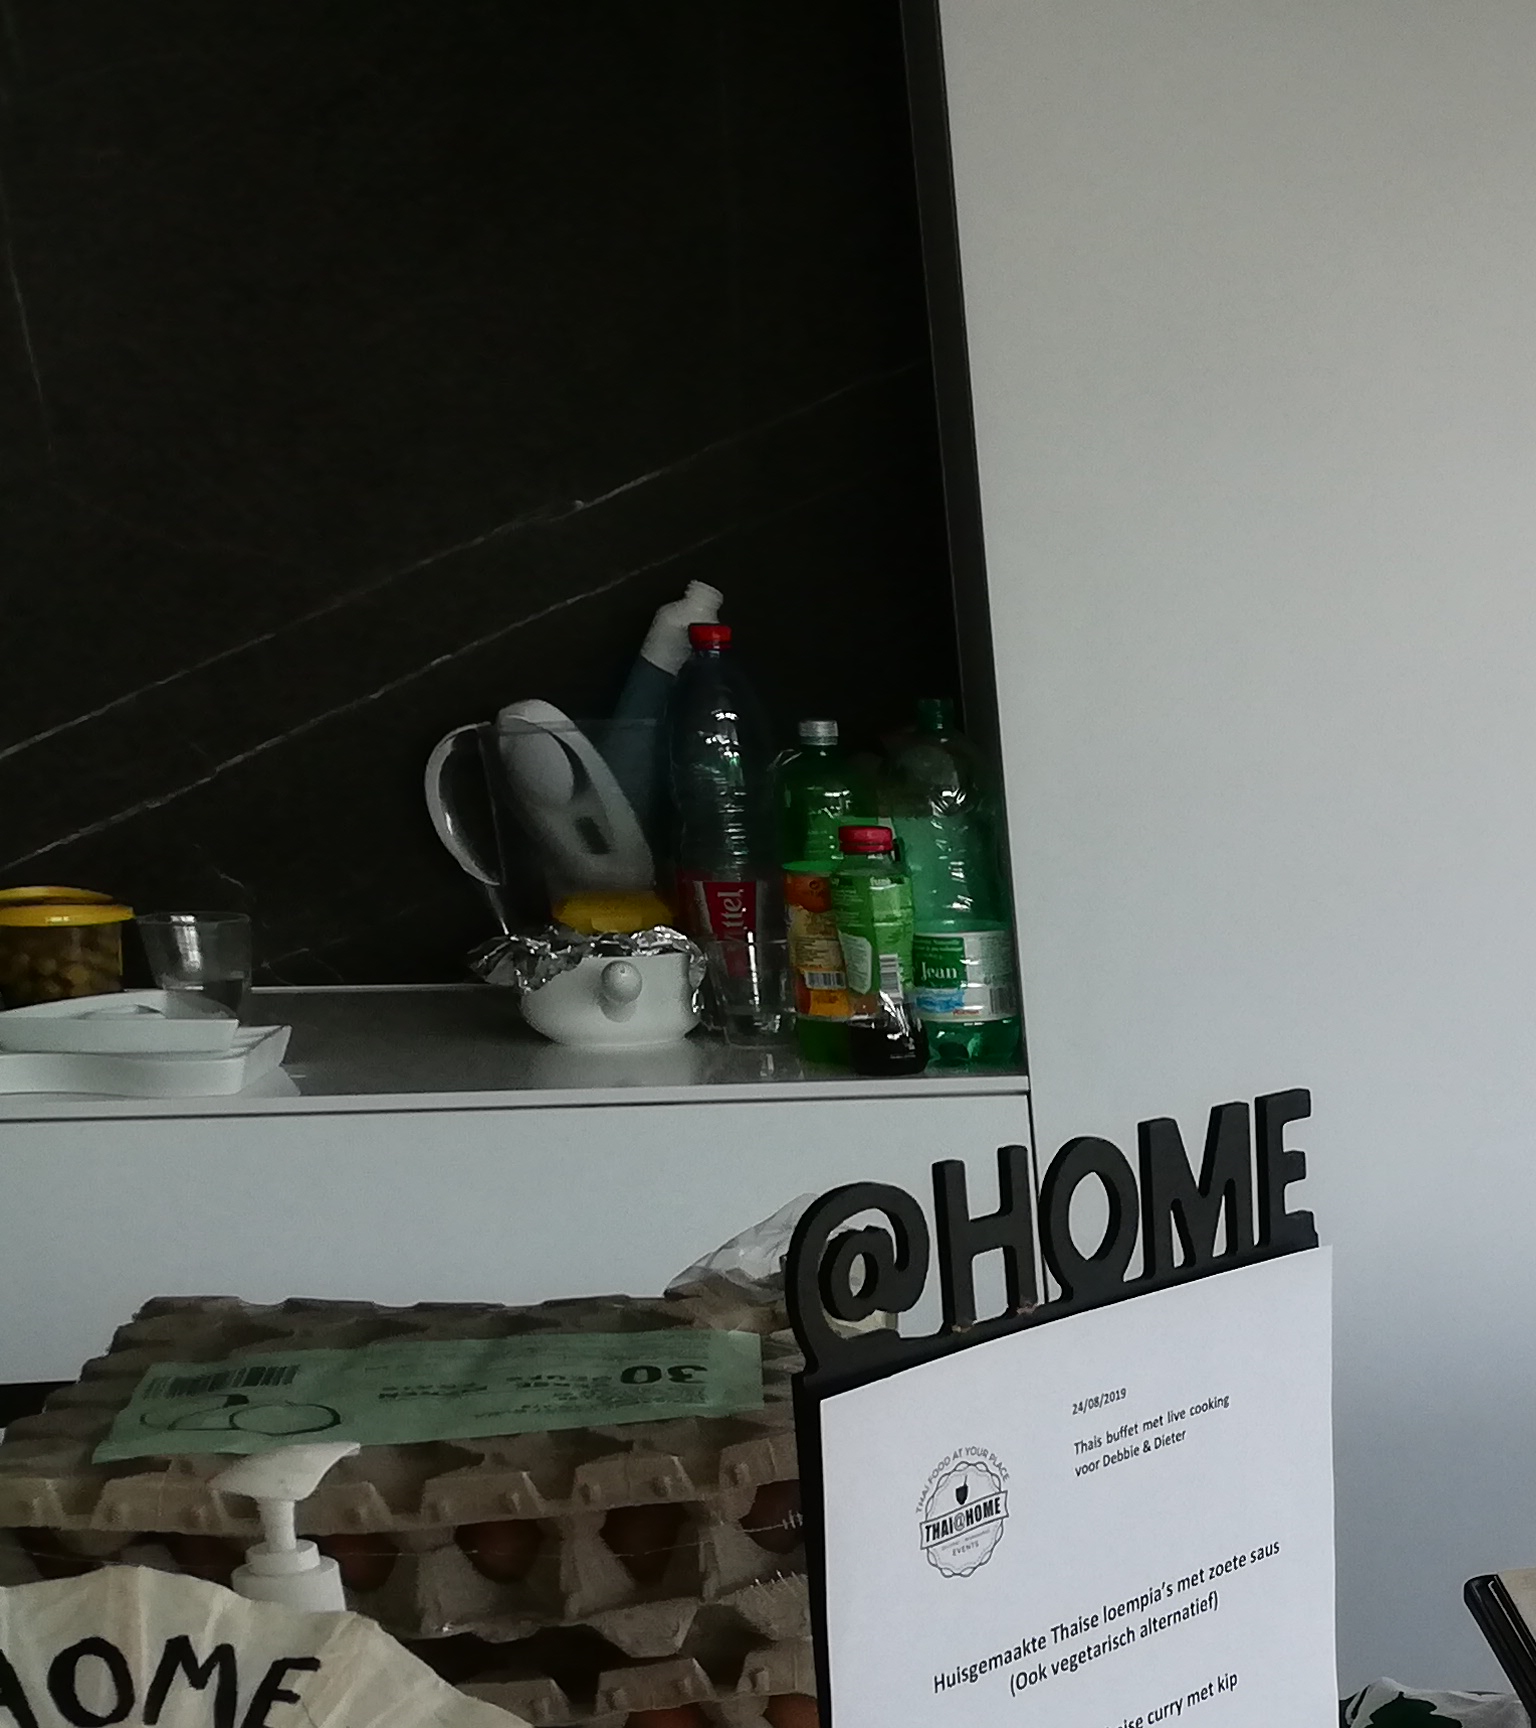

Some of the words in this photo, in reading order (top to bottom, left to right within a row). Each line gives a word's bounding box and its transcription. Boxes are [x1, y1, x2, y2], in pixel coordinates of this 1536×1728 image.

[921, 961, 958, 981] Jean
[785, 1088, 1319, 1350] @HOME
[620, 1365, 708, 1385] 30
[1072, 1388, 1127, 1415] 24/08/2019
[1073, 1435, 1102, 1455] Thais
[1106, 1423, 1139, 1444] buffet
[1142, 1415, 1164, 1432] met
[1167, 1409, 1186, 1423] live
[1189, 1395, 1230, 1416] cooking
[928, 1455, 951, 1485] FOOD
[952, 1447, 963, 1461] AT
[965, 1446, 989, 1459] YOUR
[988, 1453, 1010, 1482] PLACE
[1074, 1458, 1101, 1477] voor
[1102, 1445, 1140, 1467] Debbie
[1142, 1439, 1151, 1453] &
[1153, 1429, 1187, 1450] Dieter
[925, 1497, 1001, 1542] THAI@HOME
[934, 1634, 1047, 1694] Huisgemaakte
[1050, 1613, 1099, 1648] Thaise
[1176, 1568, 1206, 1593] met
[1208, 1552, 1247, 1581] zoete
[1249, 1540, 1281, 1564] saus
[1009, 1666, 1049, 1697] (Ook
[1051, 1627, 1136, 1677] vegetarisch
[1139, 1590, 1219, 1638] alternatief)
[1147, 1697, 1183, 1726] curry
[1186, 1682, 1215, 1708] met
[1217, 1672, 1238, 1693] kip
